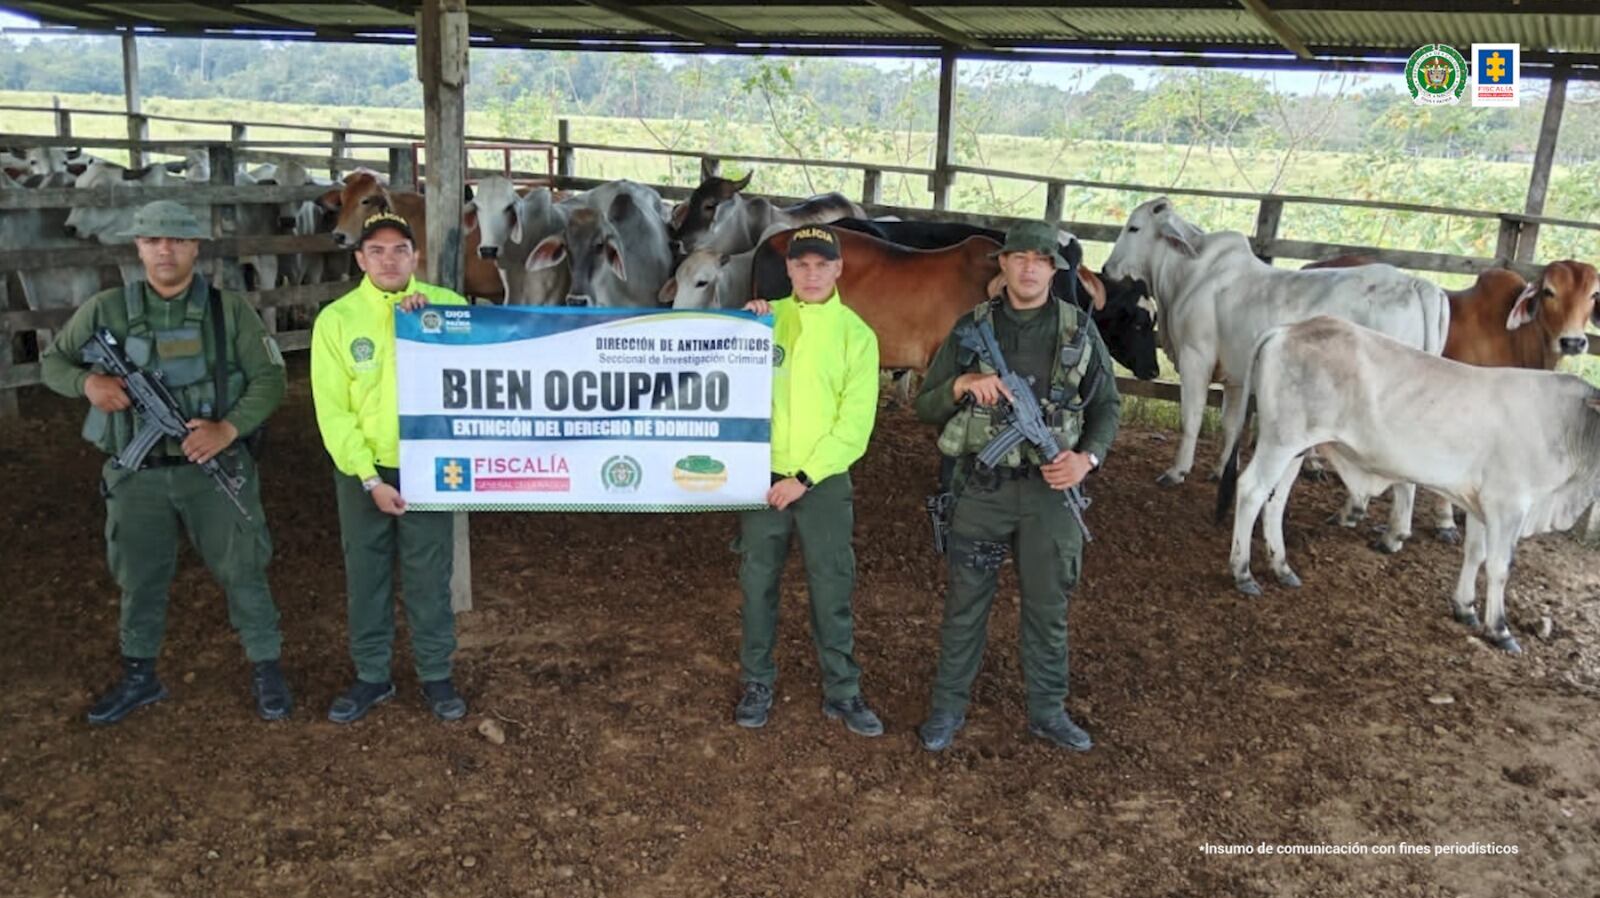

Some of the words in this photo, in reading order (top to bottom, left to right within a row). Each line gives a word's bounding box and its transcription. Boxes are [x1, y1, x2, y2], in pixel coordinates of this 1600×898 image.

[444, 310, 471, 318] DIOS
[596, 335, 655, 351] DIRECCIÓN
[660, 338, 674, 351] DE
[678, 335, 770, 352] ANTINARCÓTICOS
[599, 353, 646, 364] Seccional
[648, 353, 661, 364] de
[663, 352, 725, 366] Investigación
[728, 353, 767, 365] Criminal
[442, 368, 531, 411] BIEN
[544, 369, 730, 413] OCUPADO
[452, 416, 533, 436] EXTINCIÓN
[535, 420, 561, 437] DEL
[564, 420, 632, 438] DERECHO
[634, 420, 652, 437] DE
[655, 420, 720, 438] DOMINIO
[474, 453, 569, 473] FISCALÍA
